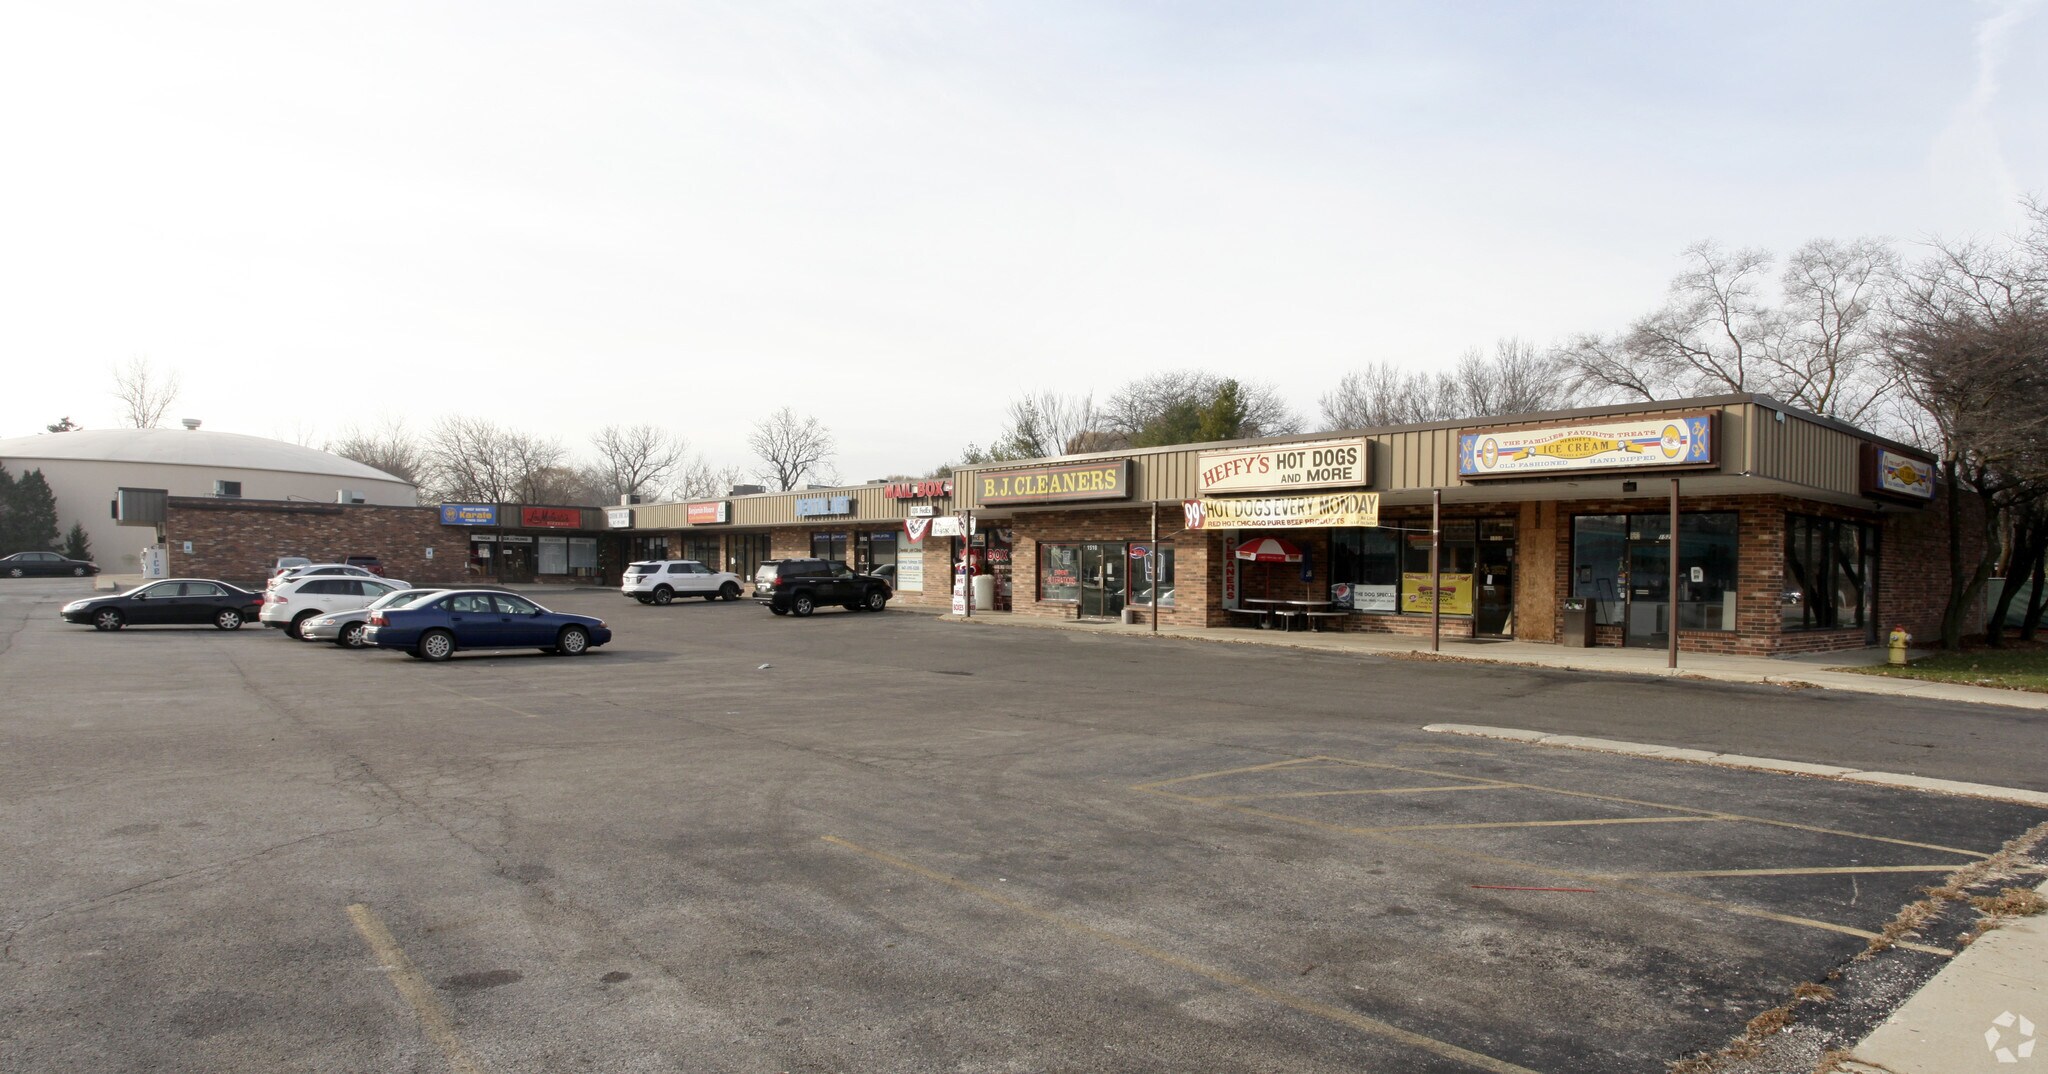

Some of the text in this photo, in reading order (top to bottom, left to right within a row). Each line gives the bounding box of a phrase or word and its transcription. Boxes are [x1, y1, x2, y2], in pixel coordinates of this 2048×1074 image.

[1523, 433, 1564, 445] FAMILIES
[1567, 430, 1614, 438] FAVORITE
[1543, 441, 1609, 454] ICE CREAM
[1202, 447, 1357, 488] HEFFY'S HOT DOGS
[1519, 460, 1568, 468] FASHIONED
[1620, 455, 1656, 463] DIPPED
[1015, 469, 1117, 495] CLEANERS
[1281, 467, 1352, 483] AND MORE
[884, 483, 913, 499] MAIL
[917, 481, 944, 497] BOX
[1206, 500, 1230, 517] HOT
[1235, 499, 1271, 517] DOGS
[1274, 496, 1314, 516] EVERY
[1319, 494, 1378, 515] MONDAY
[460, 511, 493, 519] Karate
[987, 549, 1008, 560] BOX
[1226, 537, 1235, 600] CLEANERS
